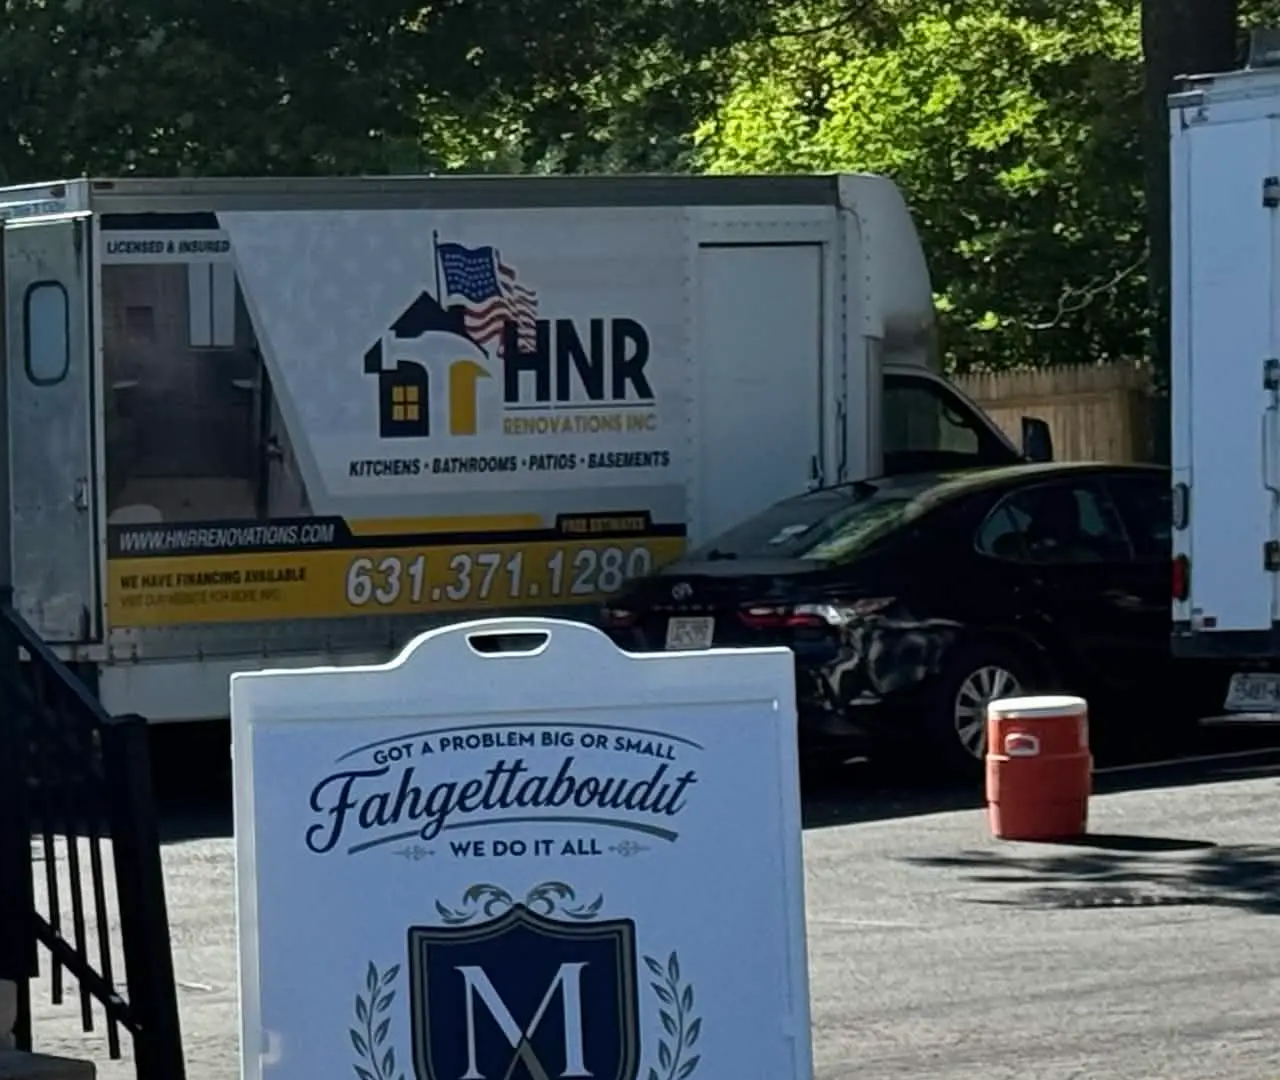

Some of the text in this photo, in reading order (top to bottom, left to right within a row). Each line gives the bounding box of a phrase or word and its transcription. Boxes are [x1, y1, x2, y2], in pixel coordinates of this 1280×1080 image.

[106, 239, 164, 254] LICENSED
[178, 239, 231, 253] INSURED
[503, 318, 655, 403] HNR
[503, 413, 658, 435] RENOVATIONS INC
[349, 450, 670, 477] KITCHENS BATHROOMS PATIOS BASEMENTS
[121, 575, 138, 589] WE
[141, 573, 173, 588] HAVE
[346, 547, 652, 605] 631.371.1280
[373, 731, 677, 766] GOT A PROBLEM BIG OR SMALL
[305, 756, 698, 854] Fahgettaboudit
[450, 839, 602, 858] WE DO IT ALL
